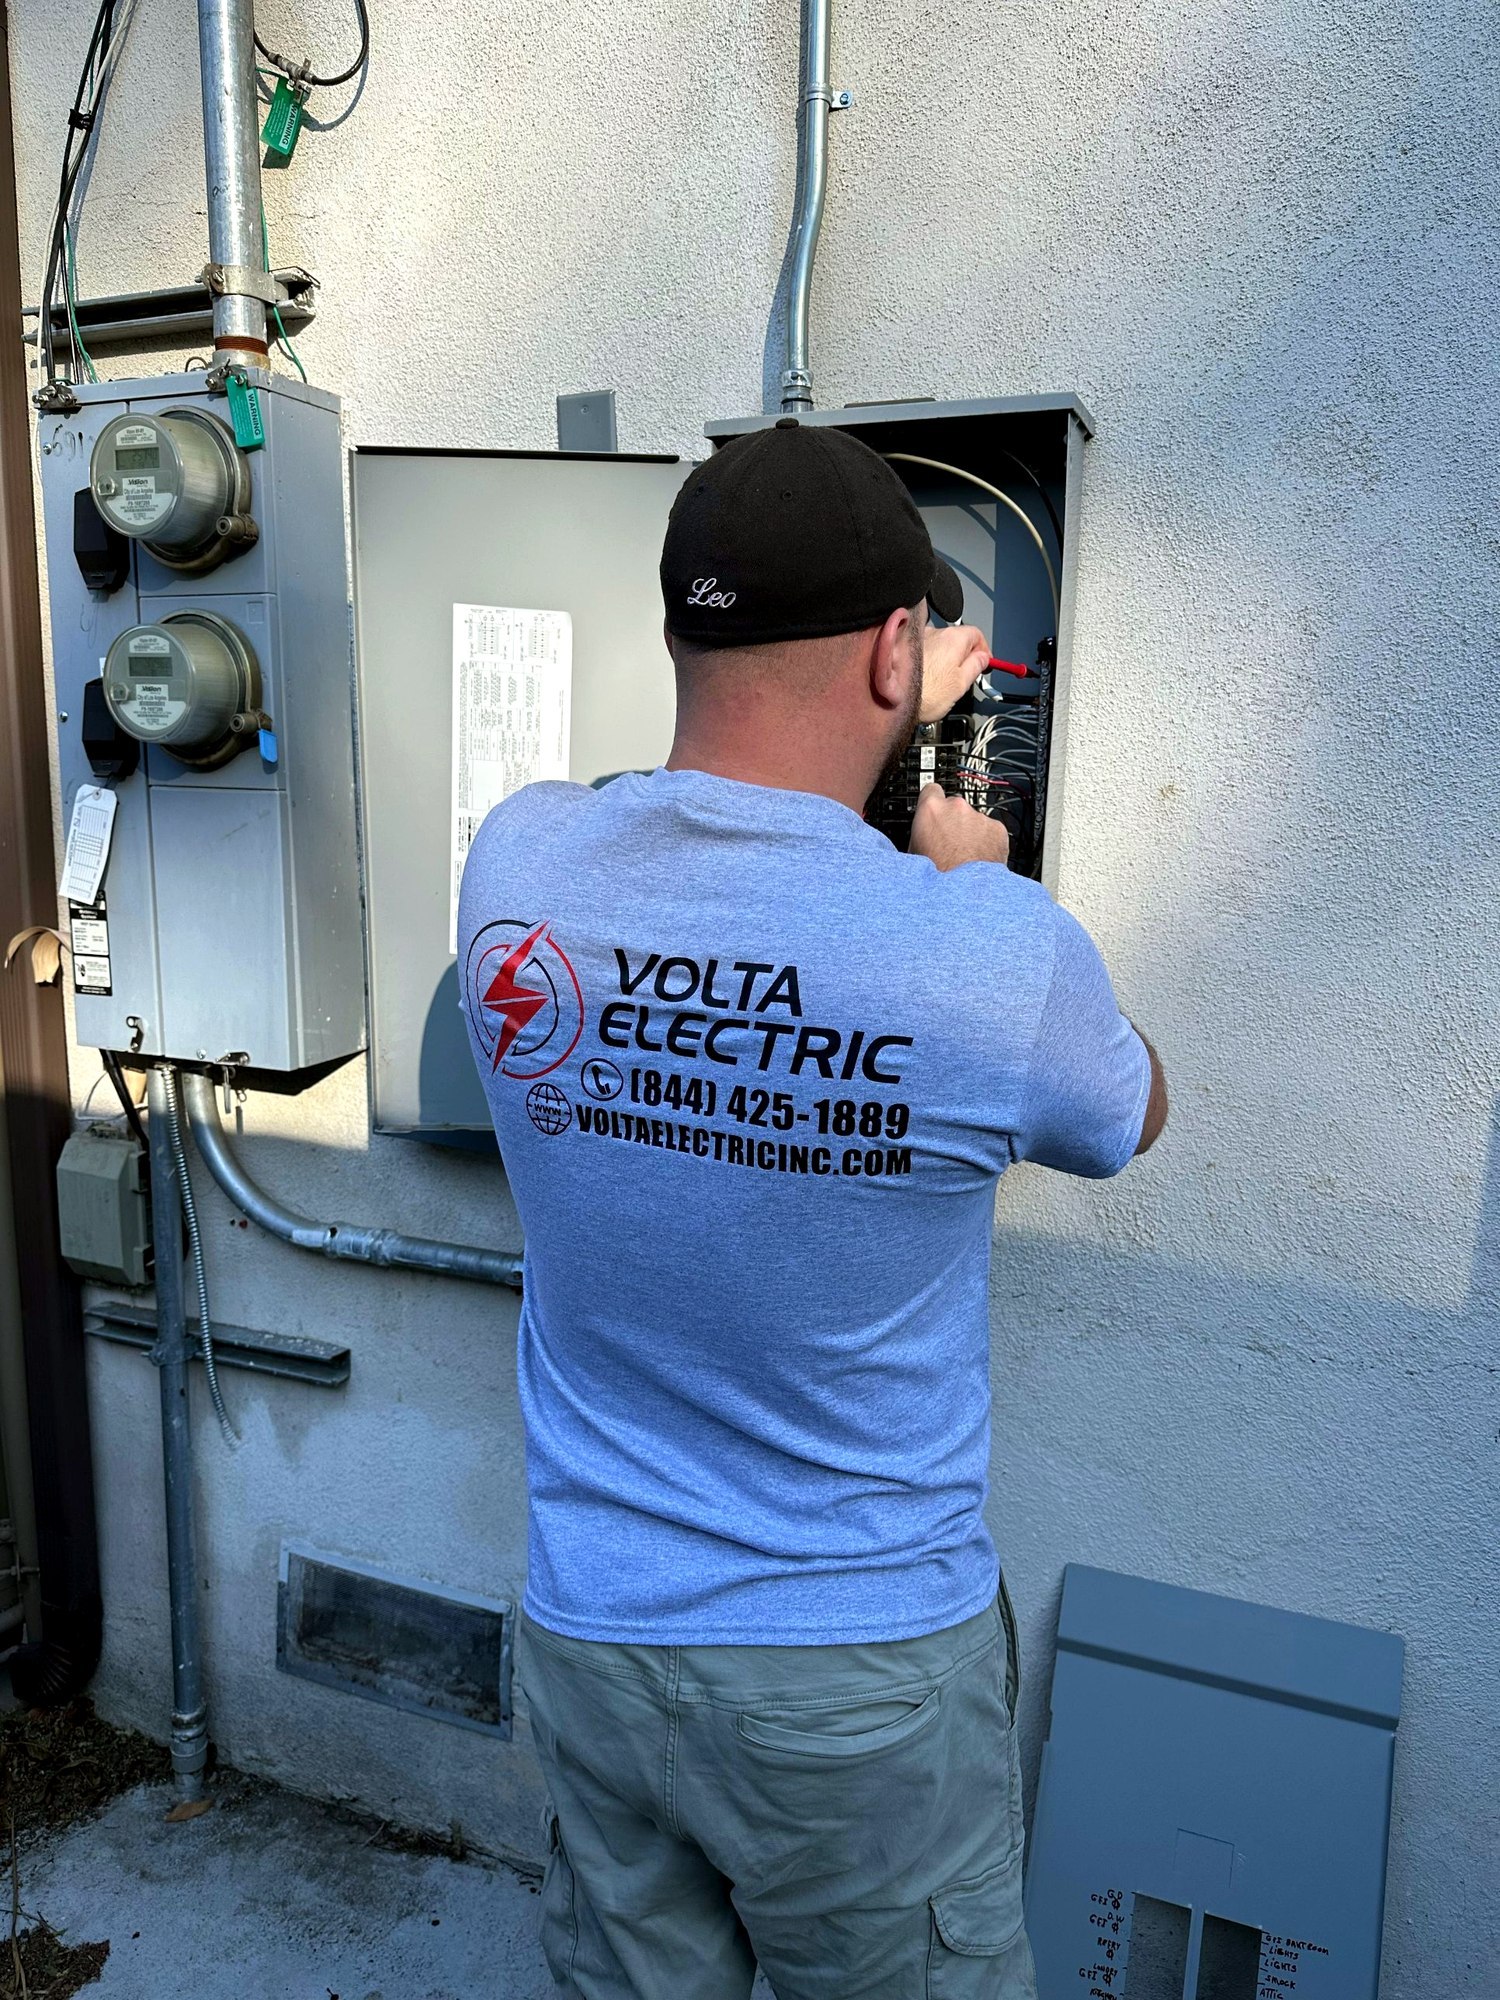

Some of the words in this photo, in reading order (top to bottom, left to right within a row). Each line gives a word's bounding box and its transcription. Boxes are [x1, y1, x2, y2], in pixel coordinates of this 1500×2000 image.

[282, 103, 298, 145] WARNING
[248, 393, 261, 436] WARNING
[687, 578, 736, 608] Leo
[613, 948, 802, 1017] VOLTA
[598, 1001, 913, 1084] ELECTRIC
[630, 1067, 717, 1117] (844)
[727, 1085, 911, 1140] 425-1889
[576, 1103, 912, 1176] VOLTAELECTRICINC.COM
[1091, 1893, 1108, 1905] GFI
[1090, 1914, 1108, 1928] GFI
[1079, 1967, 1098, 1981] GFI
